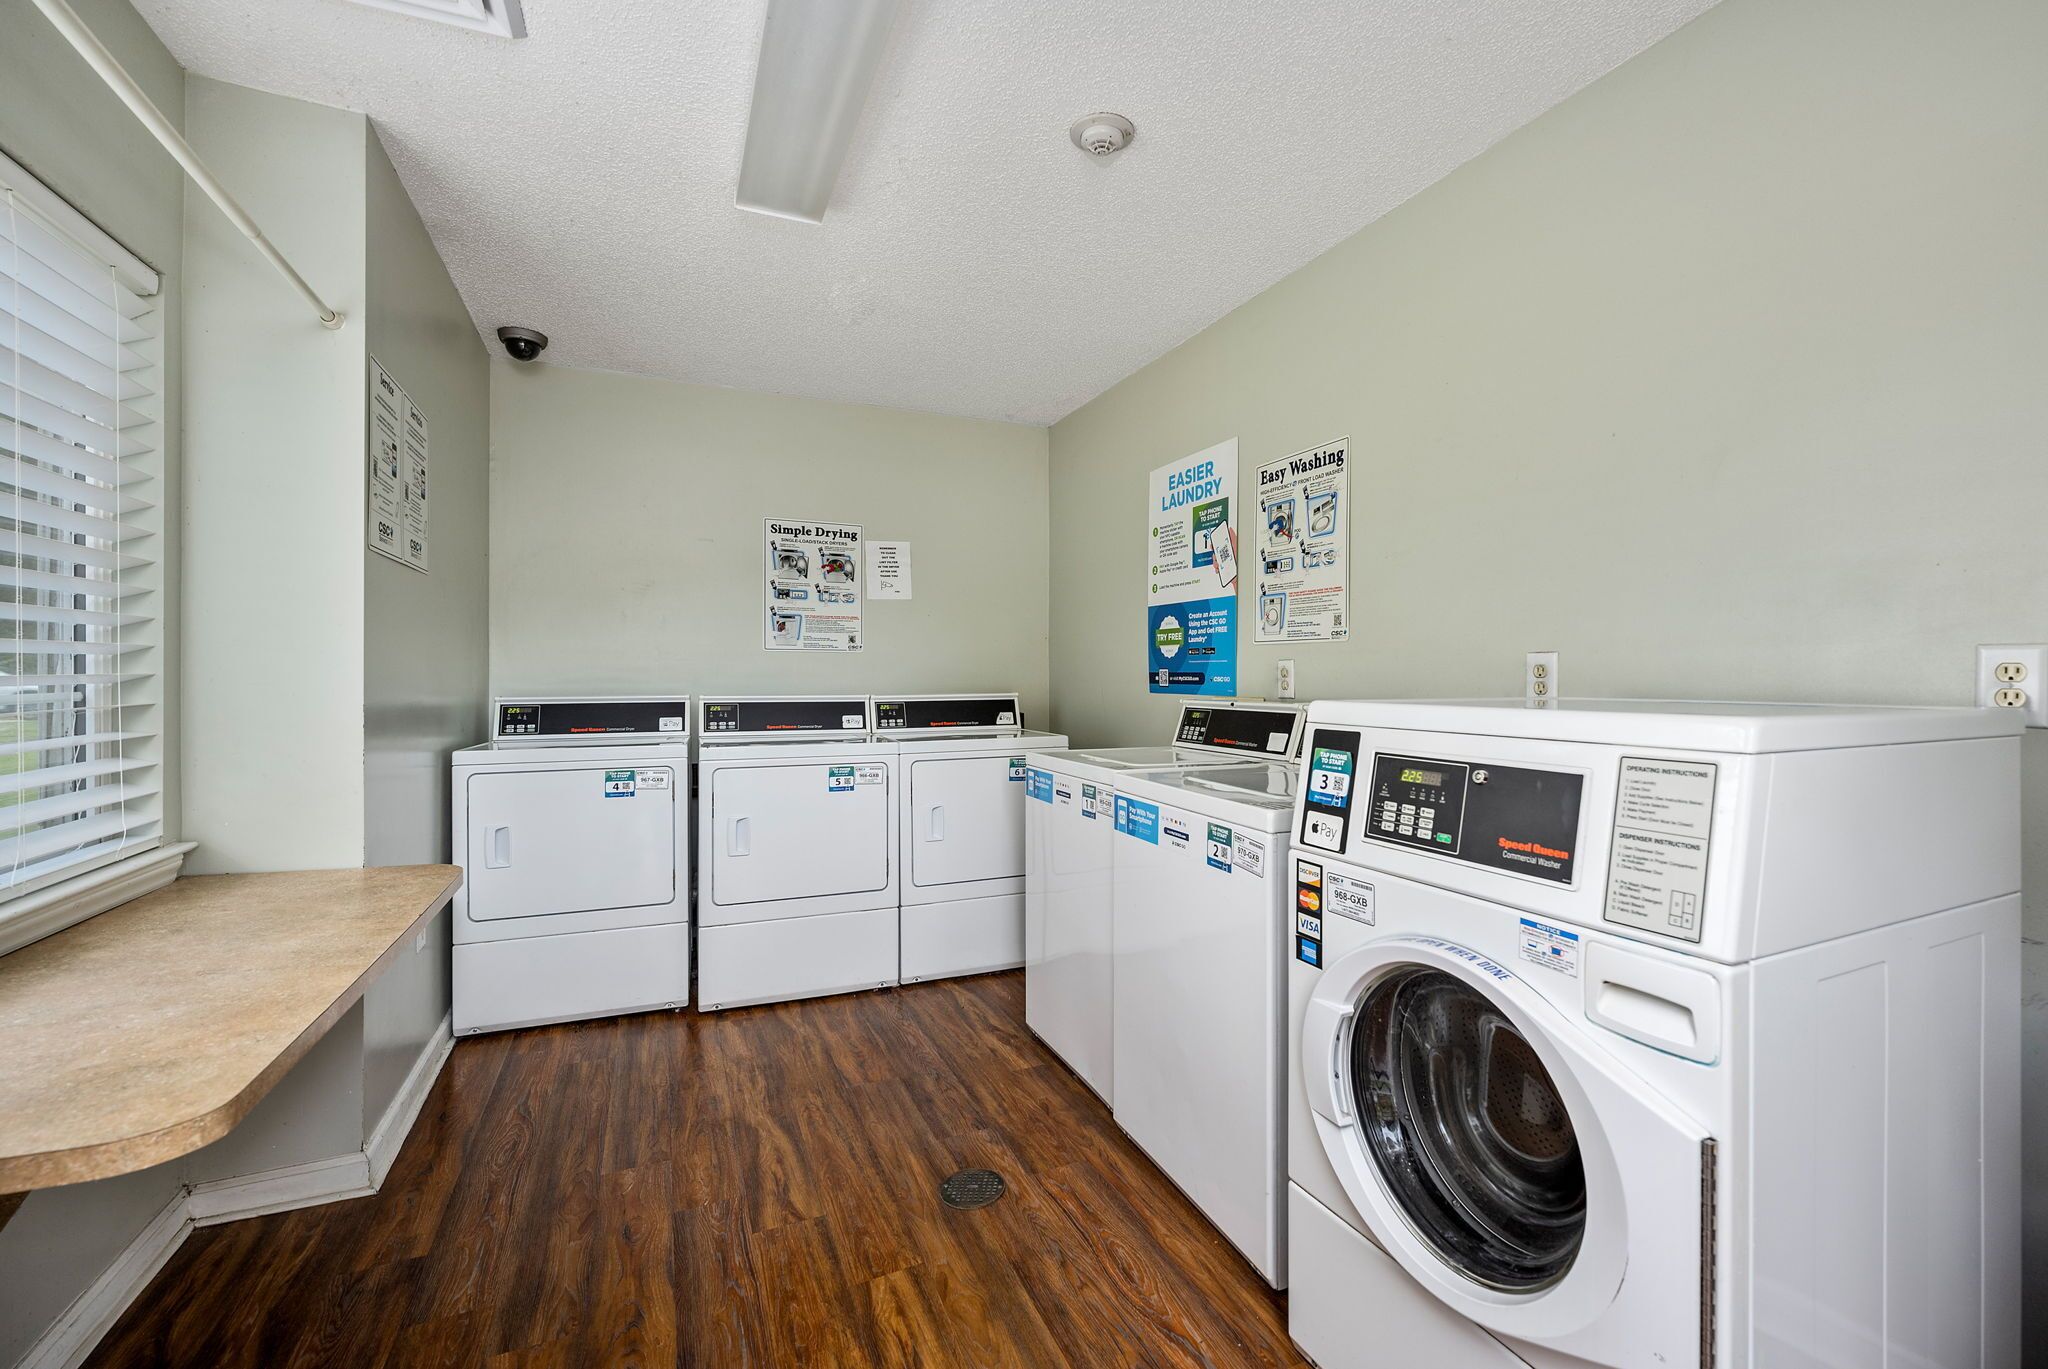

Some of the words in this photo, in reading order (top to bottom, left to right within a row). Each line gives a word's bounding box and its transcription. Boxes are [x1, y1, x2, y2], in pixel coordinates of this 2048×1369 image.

[1260, 468, 1286, 485] Easy
[1289, 449, 1344, 476] Washing
[1169, 461, 1214, 490] EASIER
[1260, 483, 1292, 495] HIGH-EFFICIENCY
[1298, 477, 1311, 485] FRONT
[1325, 467, 1344, 476] WASHER
[1162, 477, 1222, 511] LAUNDRY
[1206, 512, 1220, 520] START
[379, 521, 389, 536] CSC
[771, 523, 812, 538] Simple
[815, 527, 858, 541] Drying
[410, 539, 418, 551] CSC
[1627, 765, 1660, 774] OPERATING
[1662, 768, 1708, 778] INSTRUCTIONS
[613, 783, 619, 791] 4
[1320, 774, 1328, 790] 3
[1086, 800, 1088, 809] 1
[1129, 813, 1152, 825] Smartphone
[1320, 823, 1337, 841] Pay
[1499, 838, 1532, 852] Speed
[1533, 843, 1568, 859] Queen
[1619, 833, 1652, 842] DISPENSER
[1654, 838, 1700, 851] INSTRUCTIONS
[1214, 844, 1218, 857] 2
[1238, 846, 1259, 862] 970-GXB
[1502, 850, 1537, 864] Commercial
[1538, 858, 1562, 869] Washer
[1300, 868, 1319, 877] DISCOVER
[1334, 890, 1368, 907] 968-GXB
[1300, 918, 1319, 933] VISA
[1537, 924, 1560, 936] NOTICE
[1445, 945, 1480, 961] WHEN
[1476, 961, 1512, 980] DONE
